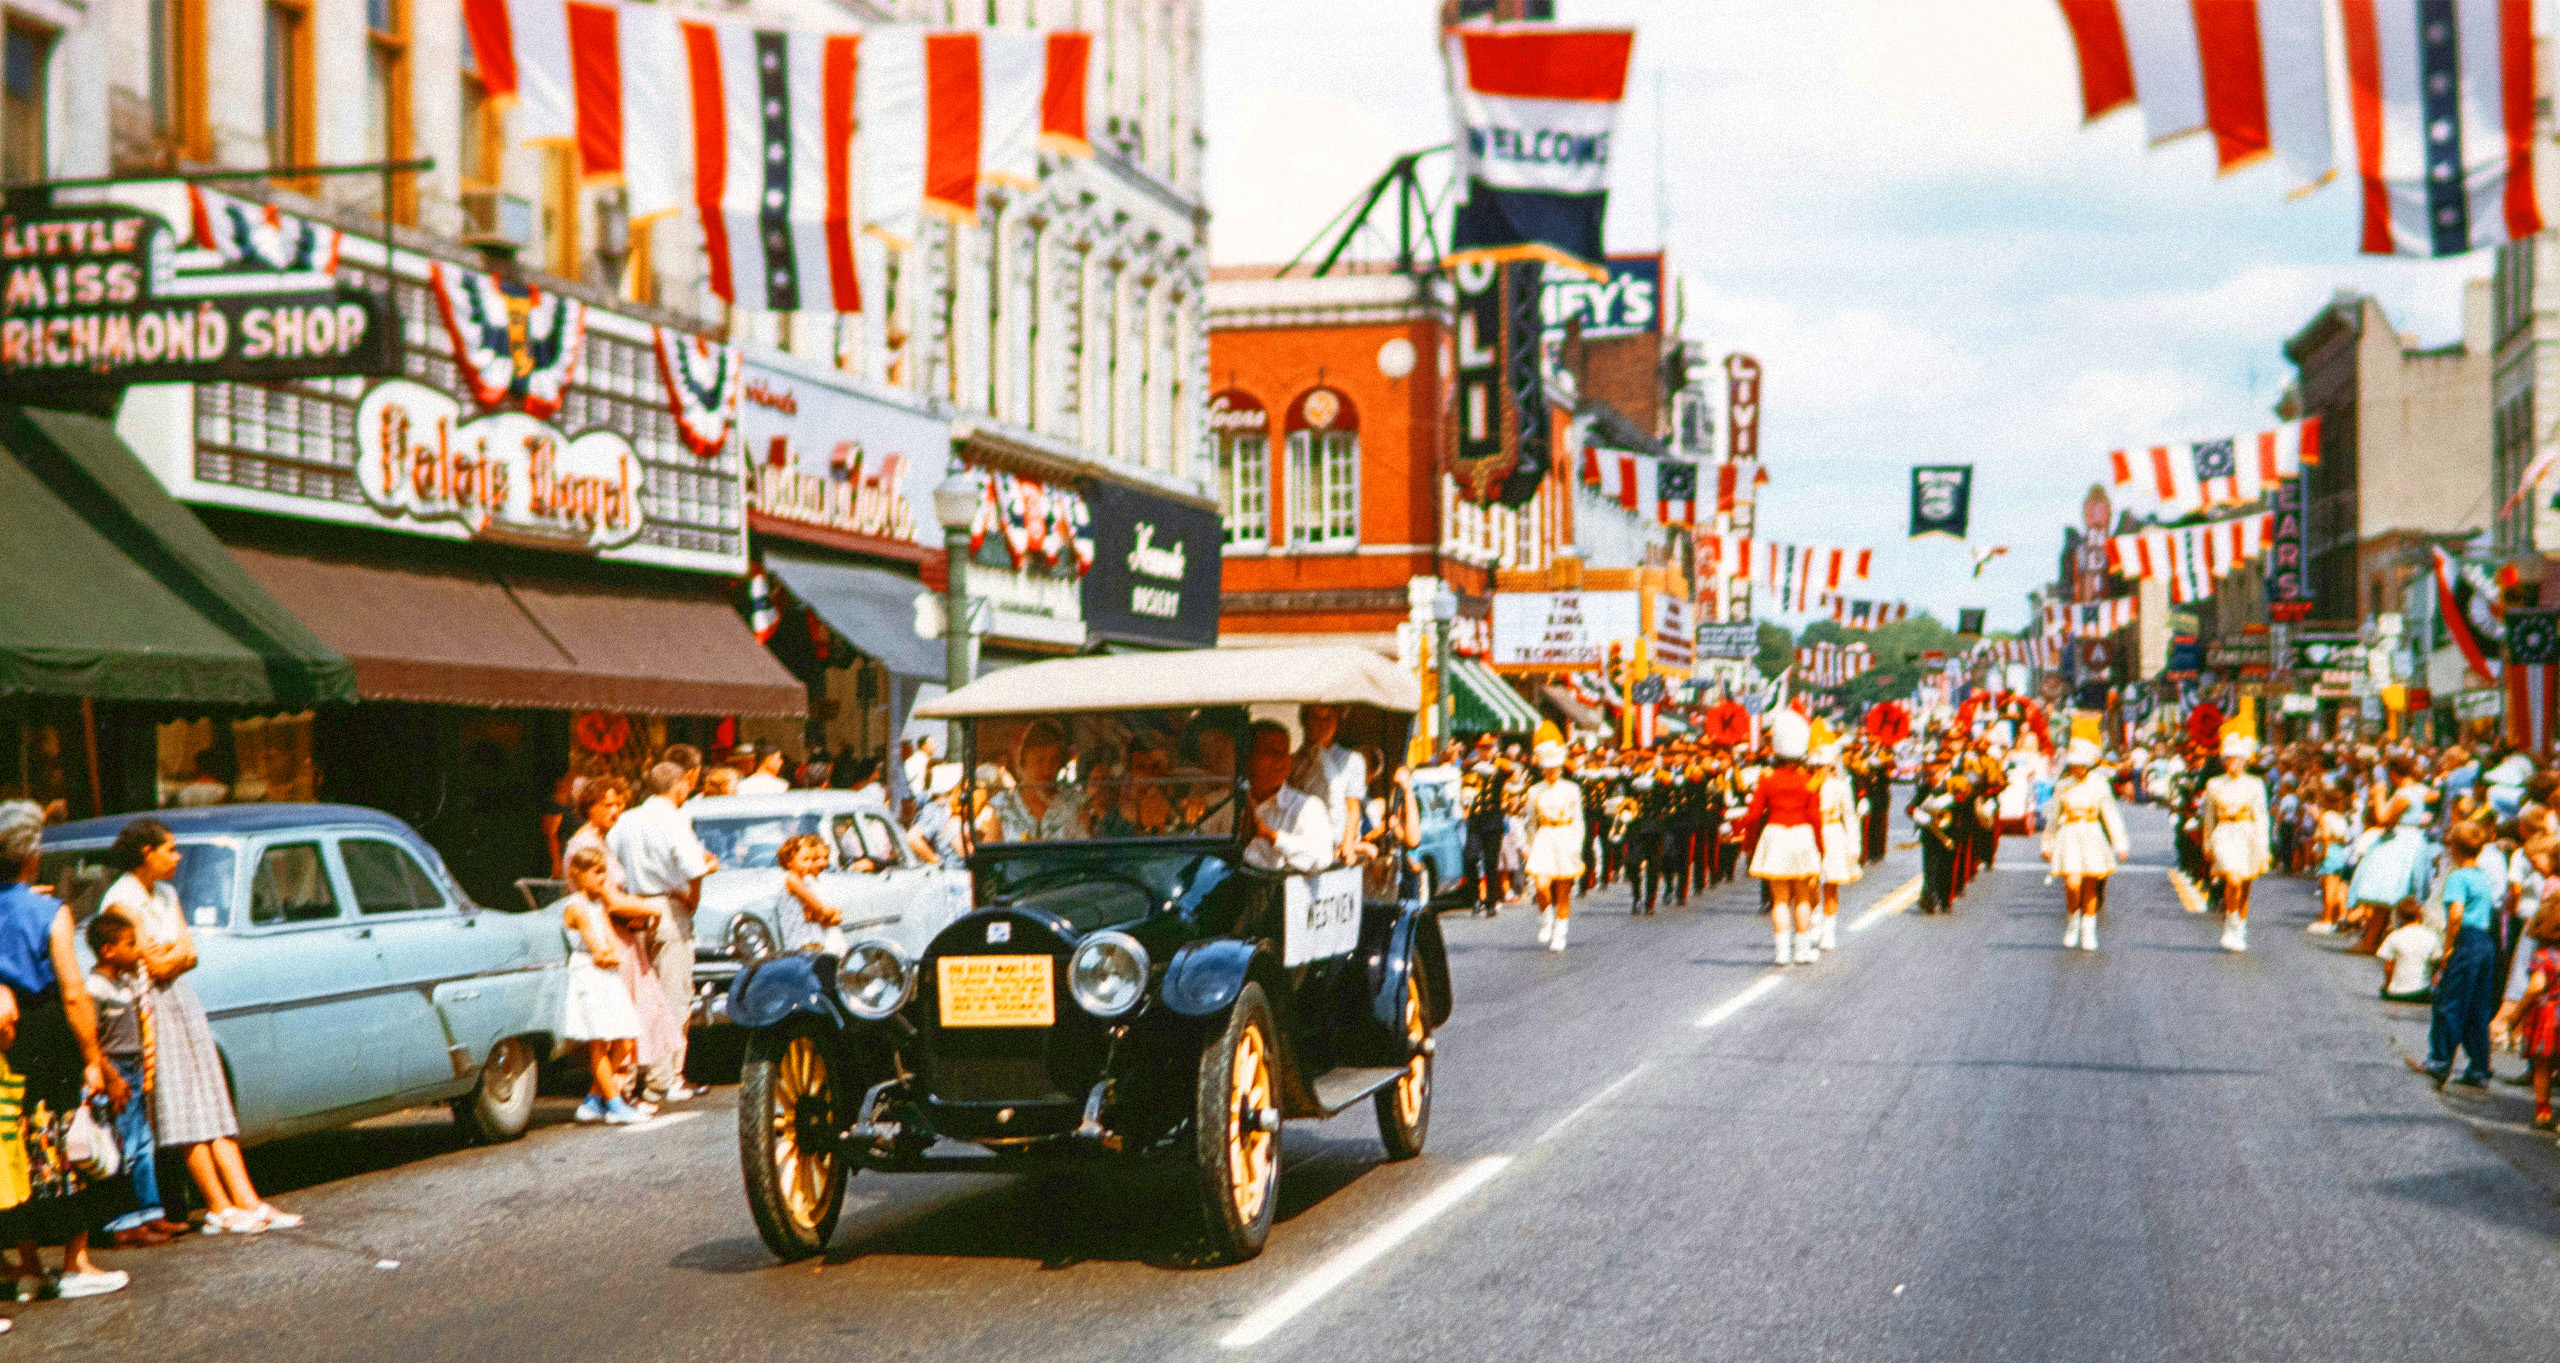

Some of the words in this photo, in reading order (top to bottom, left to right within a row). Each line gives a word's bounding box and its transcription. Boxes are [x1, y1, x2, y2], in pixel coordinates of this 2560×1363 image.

[1468, 127, 1608, 165] WELCOME
[2, 217, 143, 256] LITTLE
[5, 262, 140, 308] MISS
[2, 310, 228, 366] RICHMOND
[243, 305, 366, 358] SHOP
[2278, 483, 2300, 600] EARS
[1552, 598, 1579, 609] THE
[1543, 632, 1574, 642] AND
